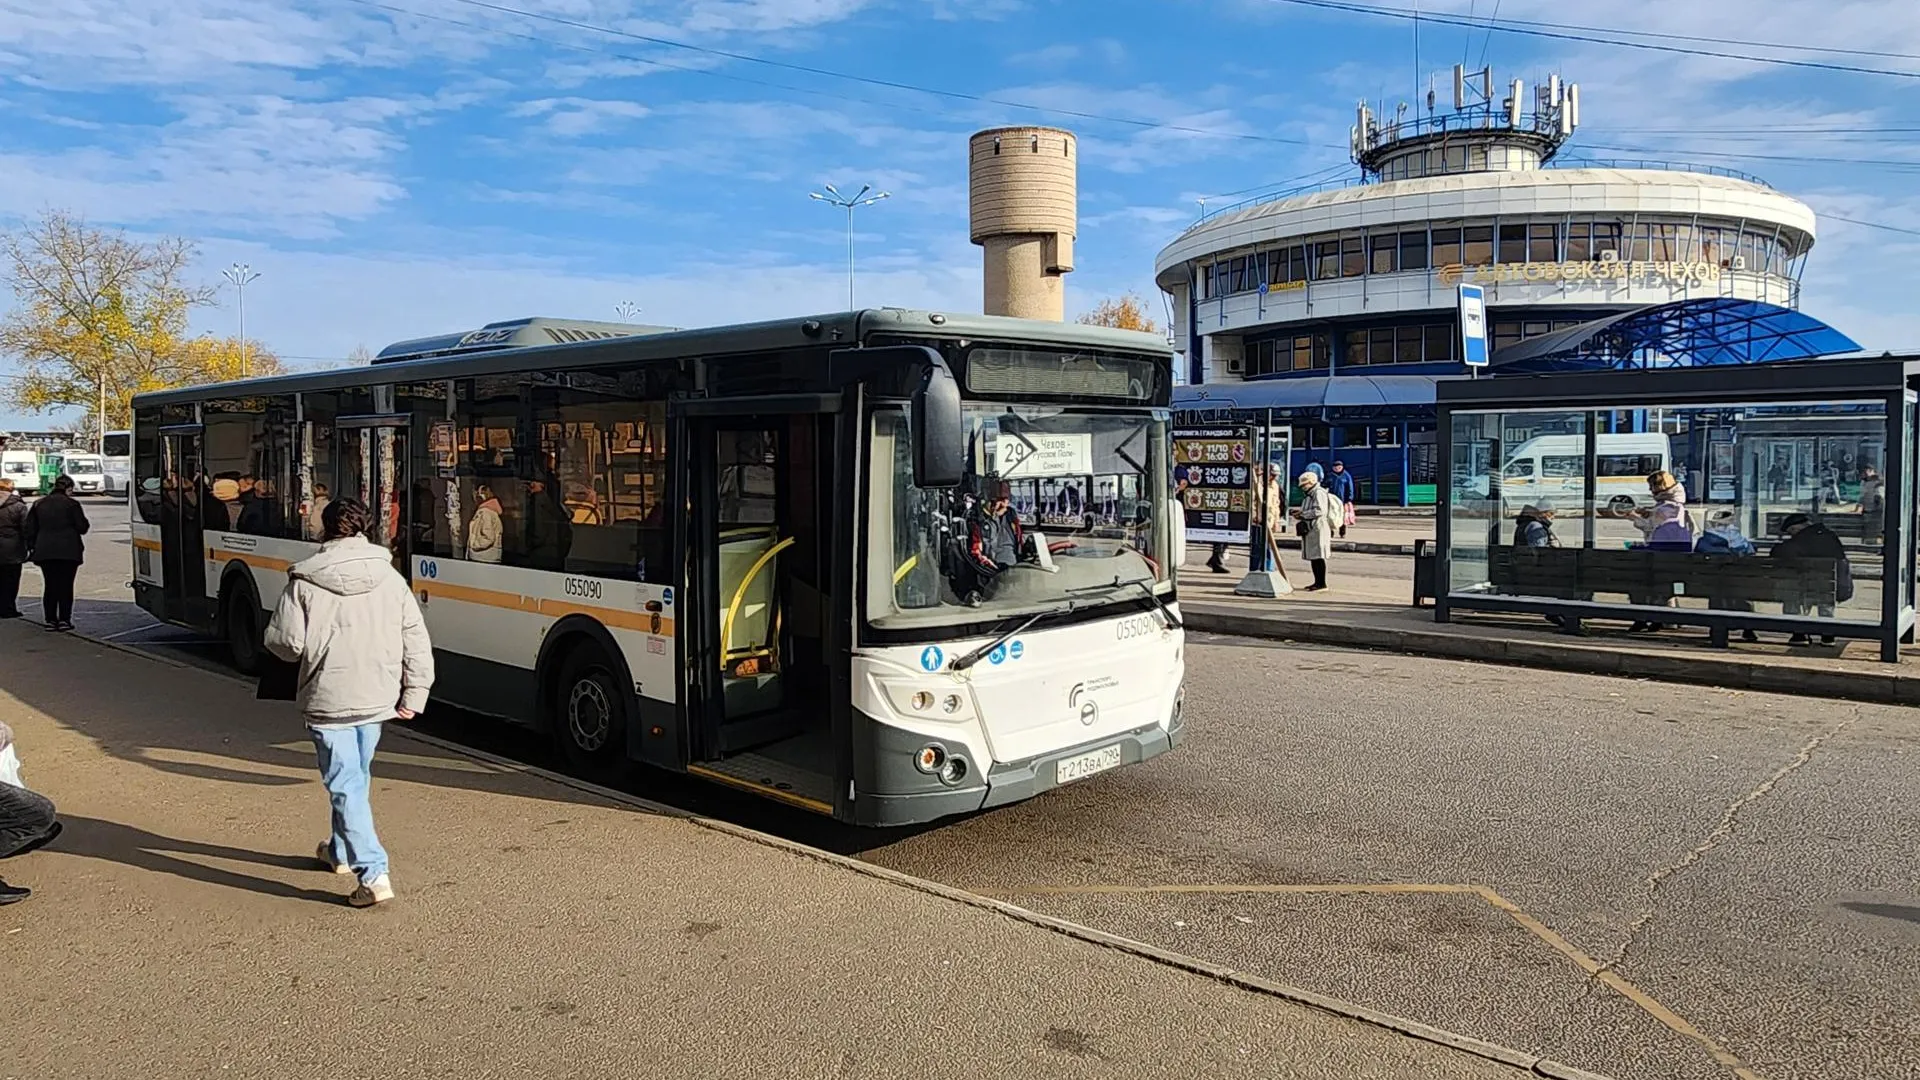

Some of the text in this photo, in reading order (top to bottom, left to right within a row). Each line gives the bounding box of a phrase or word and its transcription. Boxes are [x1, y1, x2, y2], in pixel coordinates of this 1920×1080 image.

[1473, 259, 1720, 283] АВТОВОКЗАЛ ЧЕХОВ
[1041, 438, 1066, 449] Чехов
[1206, 444, 1229, 452] 11/10
[1004, 443, 1024, 463] 29
[1205, 452, 1229, 461] 16:00
[1205, 467, 1229, 476] 24/10
[1205, 476, 1229, 484] 16:00
[1205, 491, 1229, 500] 31/10
[1205, 499, 1228, 508] 16:00
[564, 577, 602, 600] 055090
[1116, 614, 1155, 640] 055090
